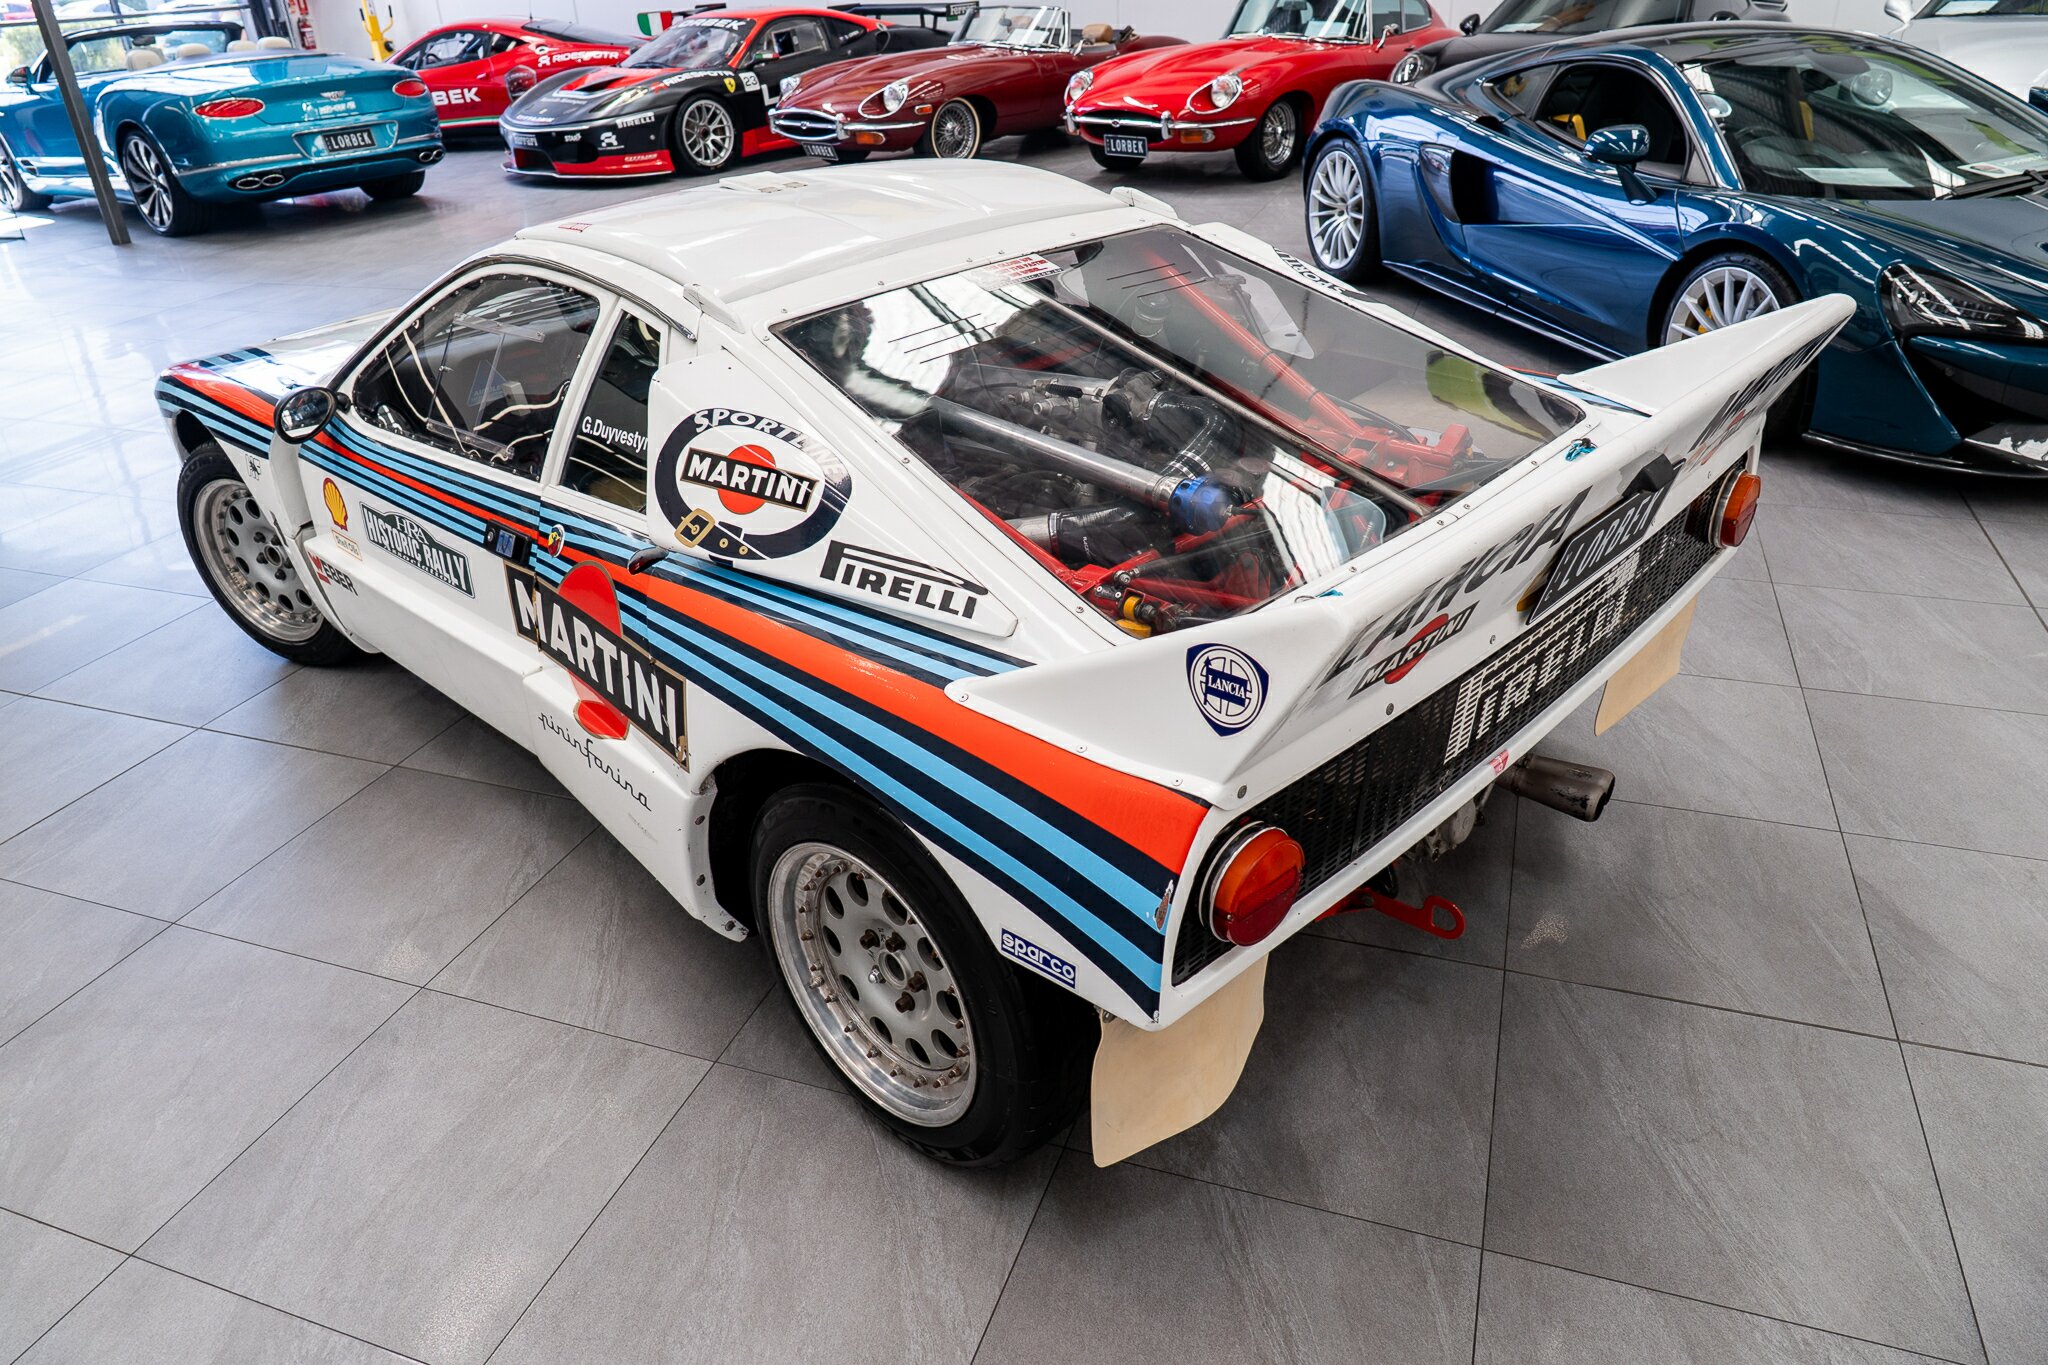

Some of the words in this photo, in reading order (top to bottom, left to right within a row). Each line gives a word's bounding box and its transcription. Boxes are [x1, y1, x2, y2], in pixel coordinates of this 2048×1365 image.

[743, 76, 757, 87] 23
[330, 132, 372, 149] LORBEK
[615, 112, 655, 129] PIRELLI
[807, 145, 834, 157] LORBEK
[1110, 138, 1144, 154] LORBEK
[687, 453, 810, 506] MARTINI
[363, 507, 422, 563] HISTORIC
[421, 543, 467, 591] RALLY
[394, 515, 430, 545] HRA
[308, 551, 358, 596] WEBER
[820, 540, 989, 619] PIRELLI
[1314, 485, 1593, 692] LANCIA
[514, 578, 676, 746] MARTINI
[1358, 604, 1474, 690] MARTINI
[1208, 675, 1246, 699] LANCIA
[538, 712, 652, 813] pininfarina
[1002, 932, 1075, 980] sparco
